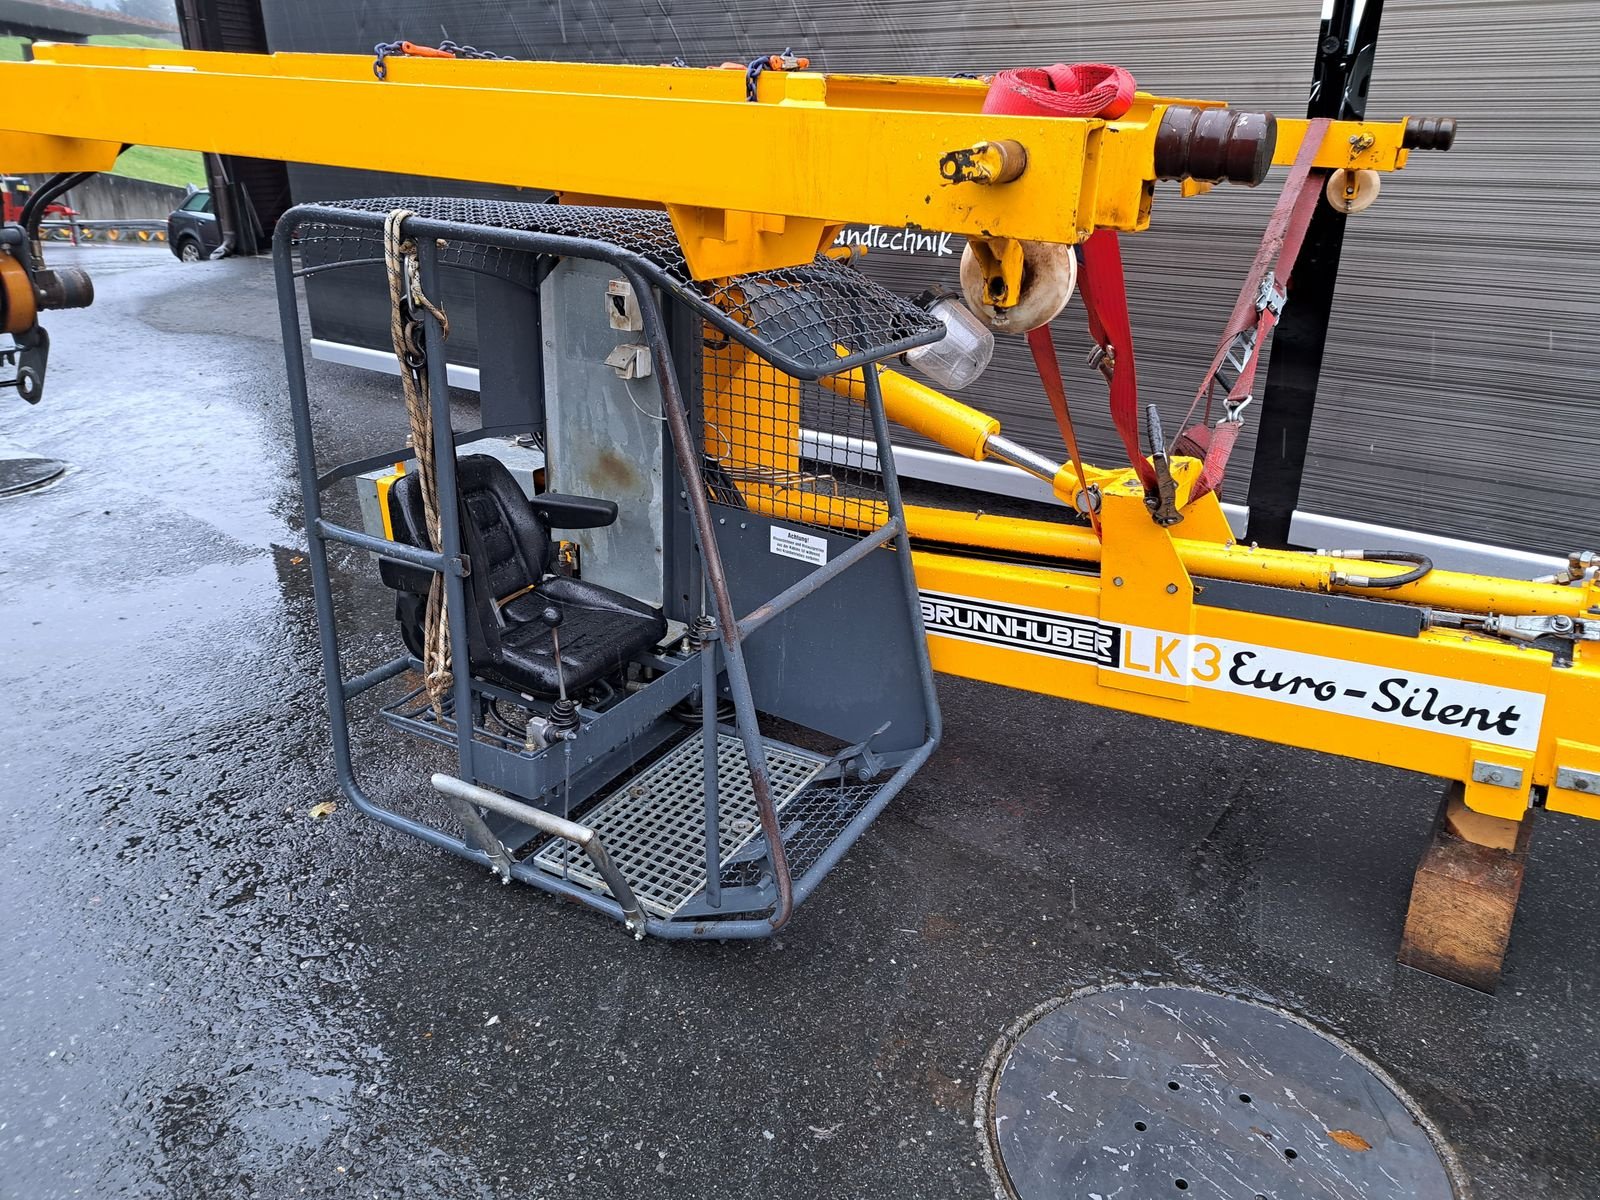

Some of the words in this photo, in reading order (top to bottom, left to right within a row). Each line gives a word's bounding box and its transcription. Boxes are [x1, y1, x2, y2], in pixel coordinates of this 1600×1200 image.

[833, 224, 953, 257] andTechnik
[788, 533, 810, 543] Achtung!
[920, 602, 1112, 656] BRUNNHUBER
[1228, 650, 1522, 736] Euro-Silent
